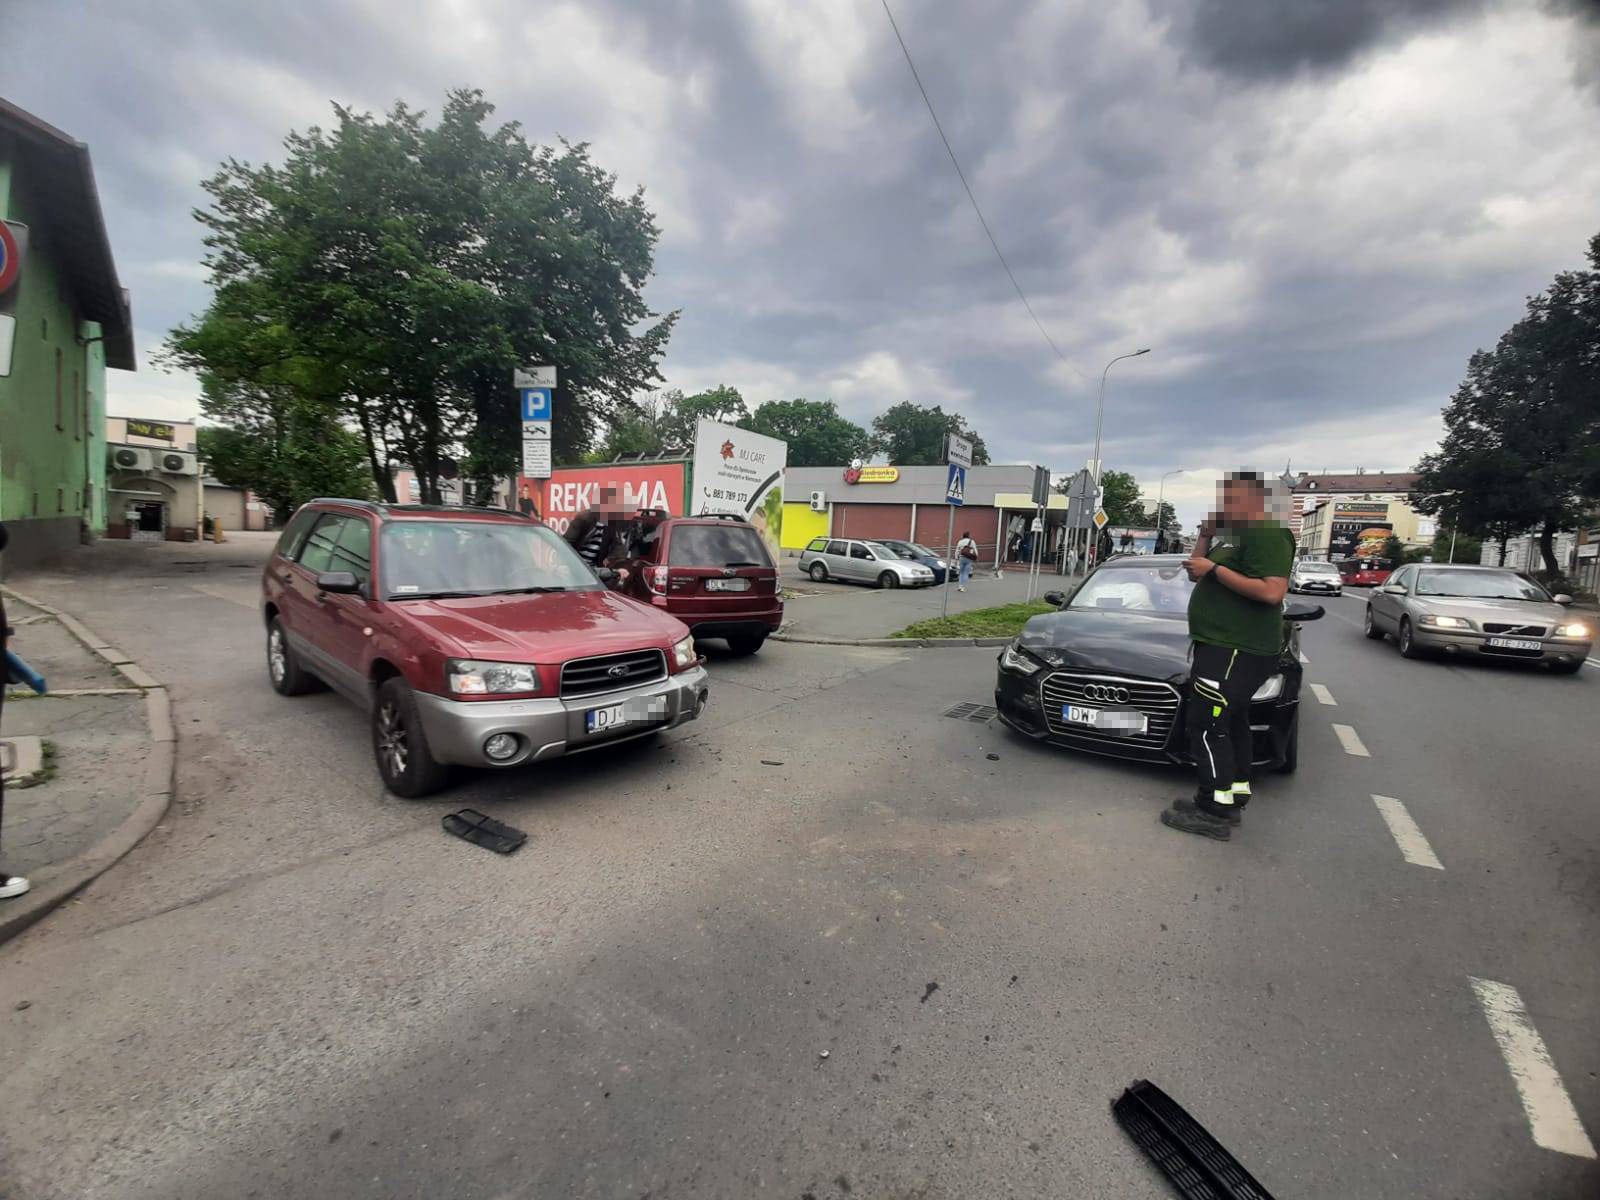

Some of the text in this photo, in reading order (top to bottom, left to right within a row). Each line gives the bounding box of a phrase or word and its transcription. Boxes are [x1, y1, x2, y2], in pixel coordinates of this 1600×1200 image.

[527, 392, 545, 417] P
[750, 451, 766, 464] CARE
[550, 480, 671, 513] REKMA
[713, 488, 748, 502] 881 789 173
